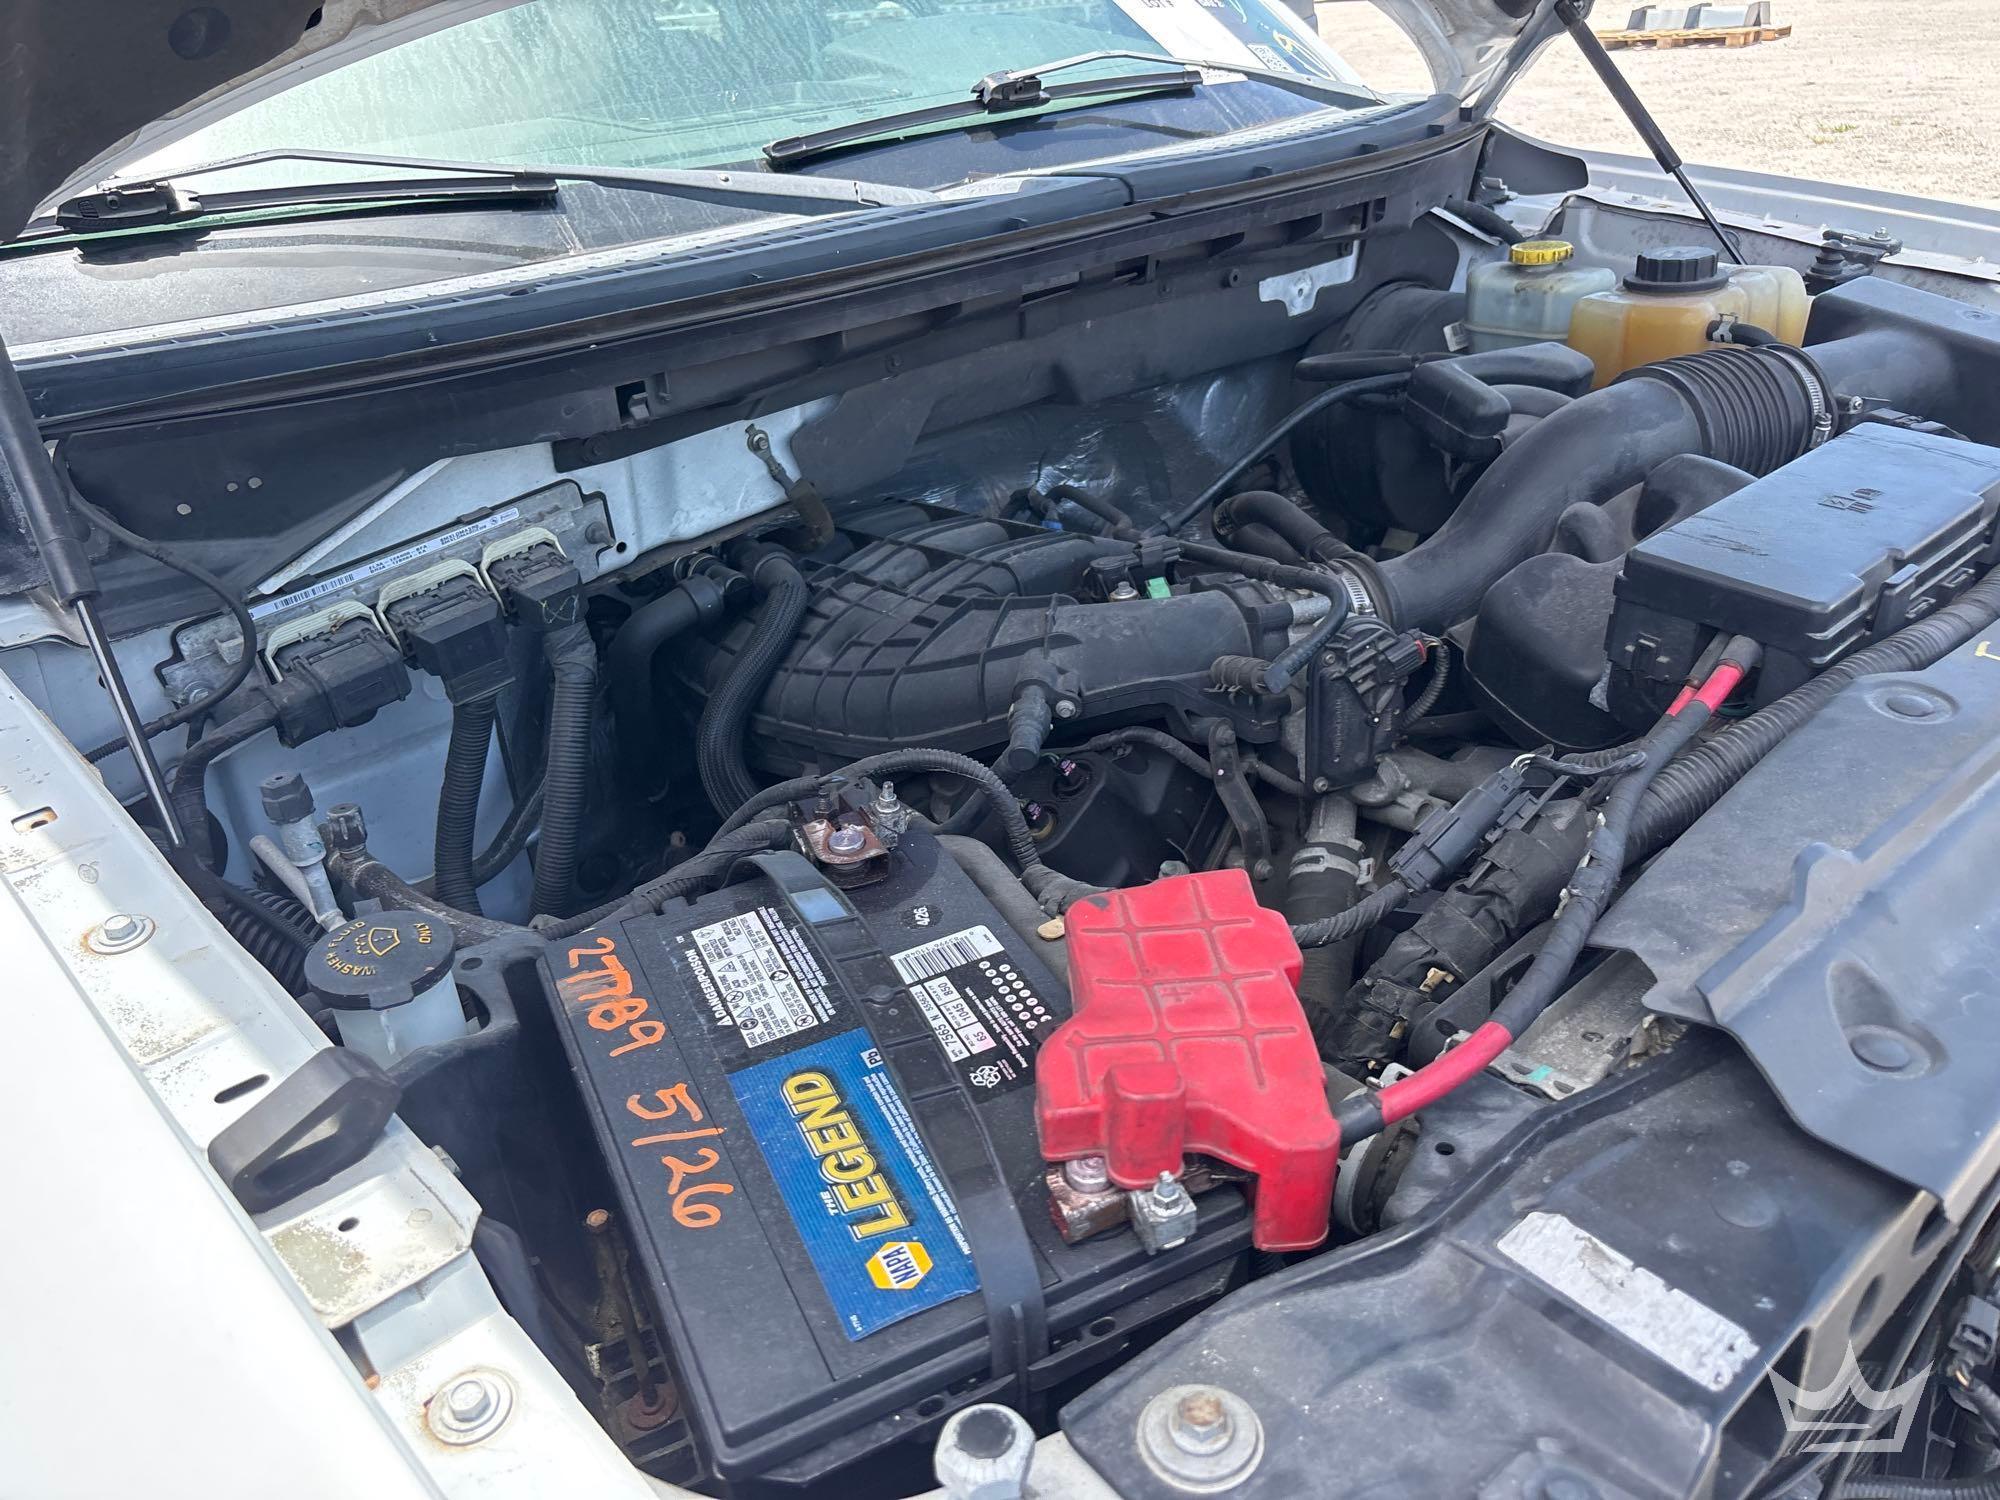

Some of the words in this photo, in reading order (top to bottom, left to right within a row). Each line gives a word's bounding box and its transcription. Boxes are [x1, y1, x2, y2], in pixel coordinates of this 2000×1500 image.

[913, 906, 930, 926] 4/26
[328, 921, 365, 947] FLUID
[414, 922, 432, 944] ONLY
[326, 952, 376, 976] WASHER
[685, 949, 727, 1018] DANGER/POISON
[938, 982, 953, 996] 850
[915, 991, 933, 1011] 555622
[952, 1003, 971, 1022] 1045
[934, 1024, 957, 1047] 7565
[973, 1031, 987, 1042] 65
[865, 1050, 882, 1065] Pb
[626, 1083, 734, 1229] 5/26
[779, 1071, 908, 1242] LEGEND
[819, 1191, 838, 1216] THE
[882, 1246, 917, 1284] NAPA
